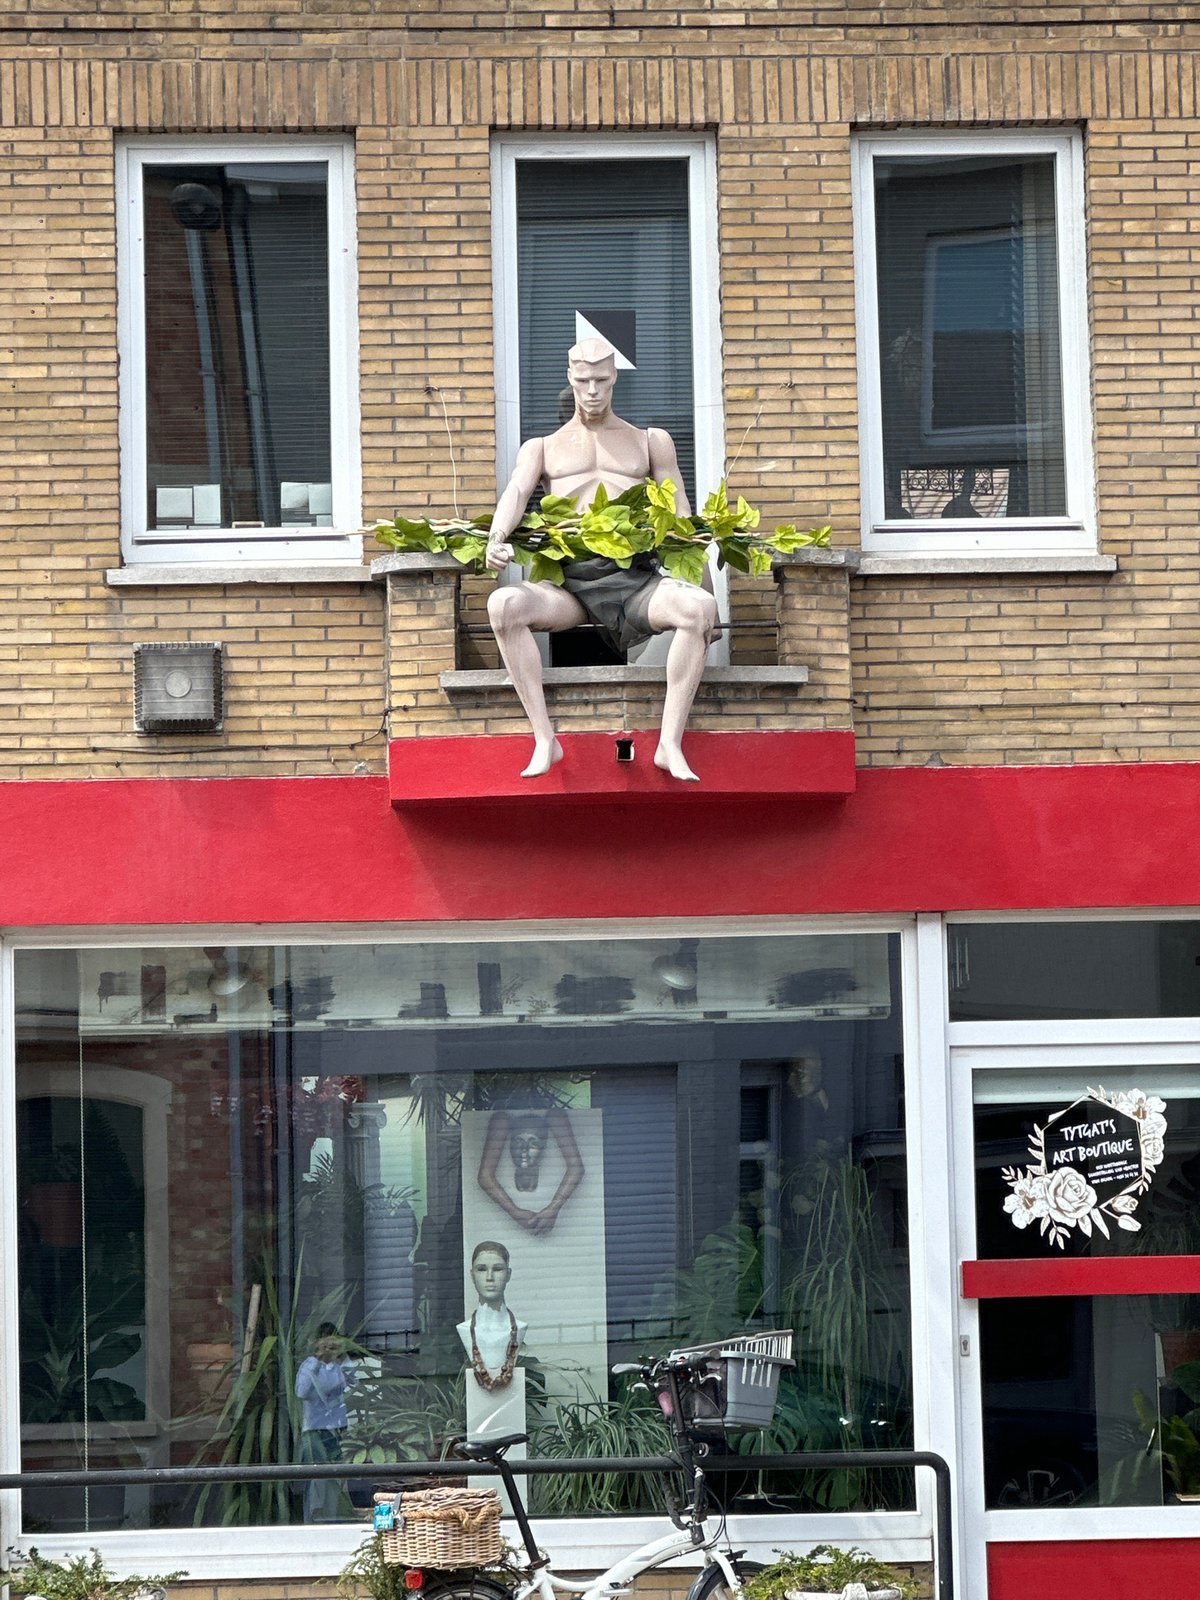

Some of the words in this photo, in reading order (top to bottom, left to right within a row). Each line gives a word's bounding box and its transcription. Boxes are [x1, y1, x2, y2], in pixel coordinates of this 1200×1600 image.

[1060, 1118, 1117, 1141] TYTGAT'S
[1052, 1146, 1076, 1165] ART
[1077, 1138, 1134, 1162] BOUTIQUE
